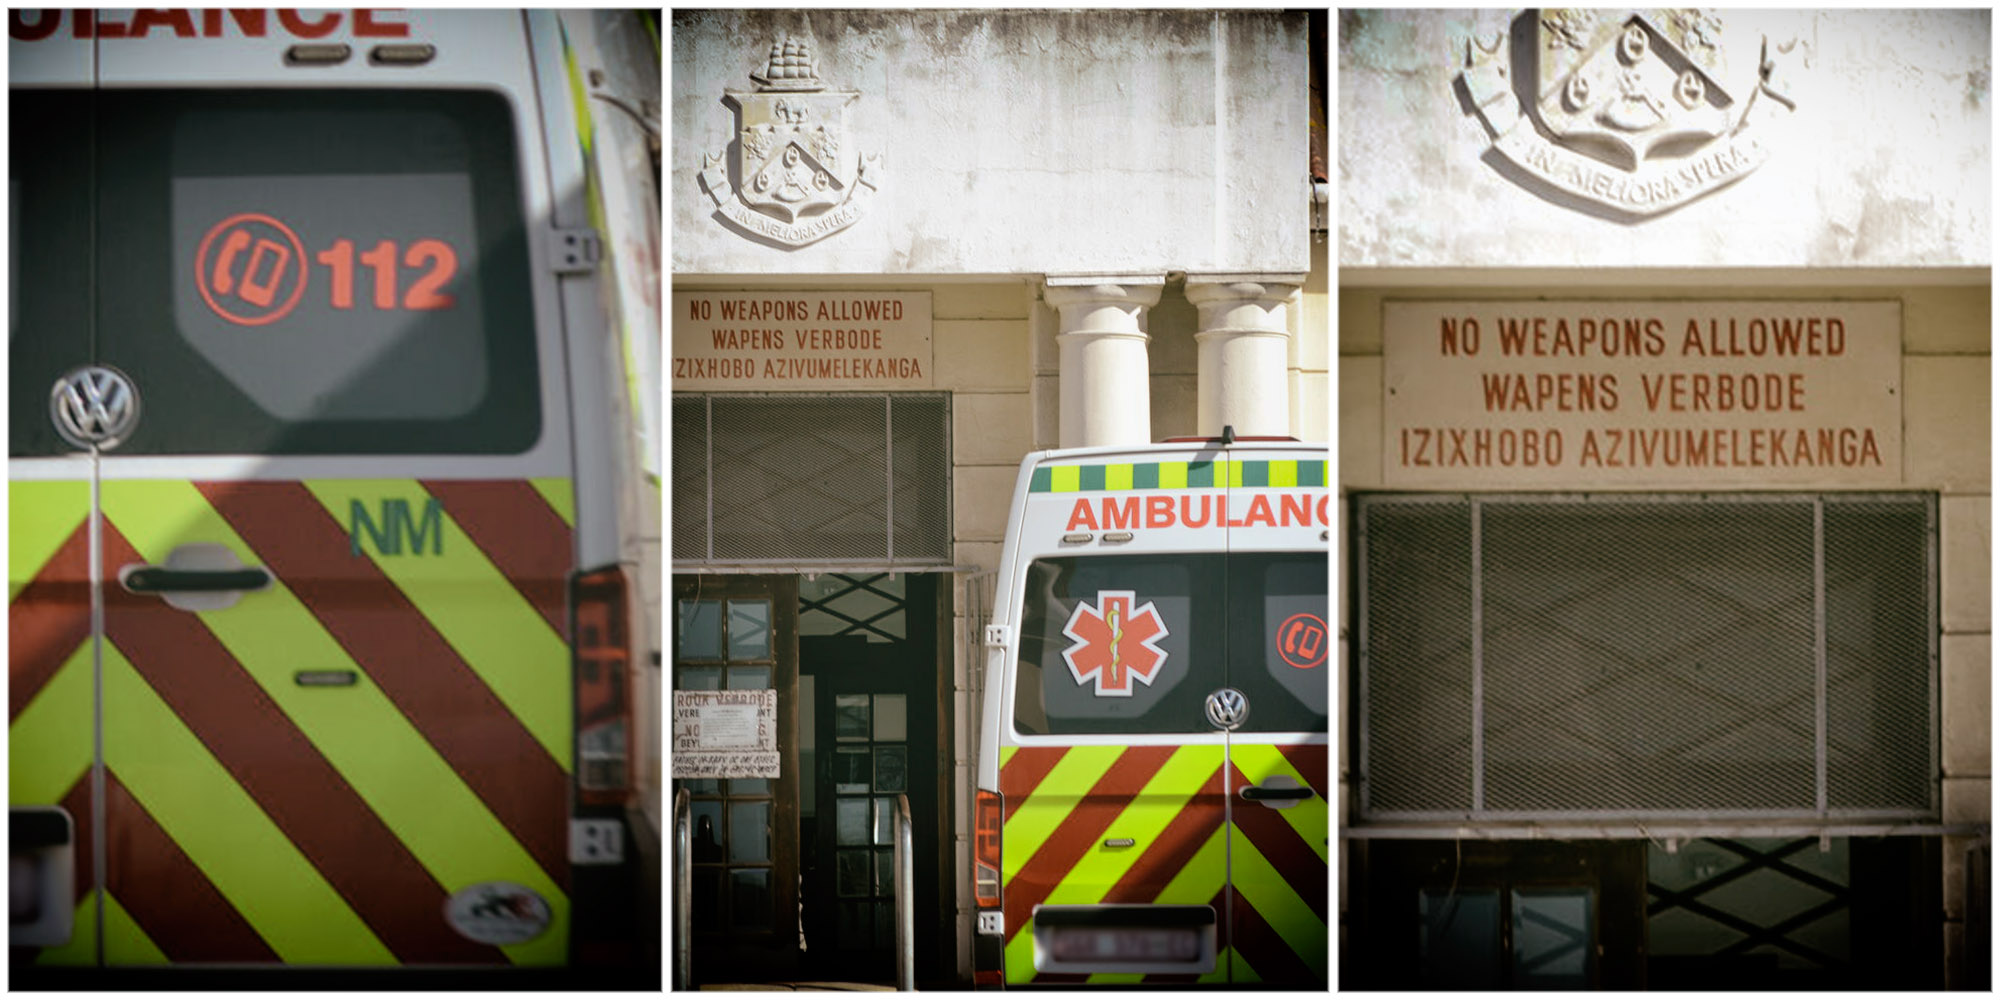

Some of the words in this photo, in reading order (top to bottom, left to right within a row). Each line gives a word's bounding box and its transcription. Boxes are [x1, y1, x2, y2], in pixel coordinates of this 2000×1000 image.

[1678, 145, 1750, 189] SPERA
[317, 238, 458, 311] 112
[690, 299, 712, 321] NO
[720, 299, 809, 321] WEAPONS
[816, 299, 903, 321] ALLOWED
[711, 329, 785, 350] WAPENS
[795, 329, 883, 350] VERBODE
[1439, 317, 1481, 356] NO
[1498, 317, 1666, 356] WEAPONS
[1681, 317, 1846, 356] ALLOWED
[763, 358, 923, 379] AZIVUMELEKANGA
[1481, 373, 1619, 412] WAPENS
[1640, 373, 1806, 412] VERBODE
[1400, 428, 1563, 468] IZIXHOBO
[1580, 428, 1883, 468] AZIVUMELEKANGA
[350, 498, 443, 557] NM
